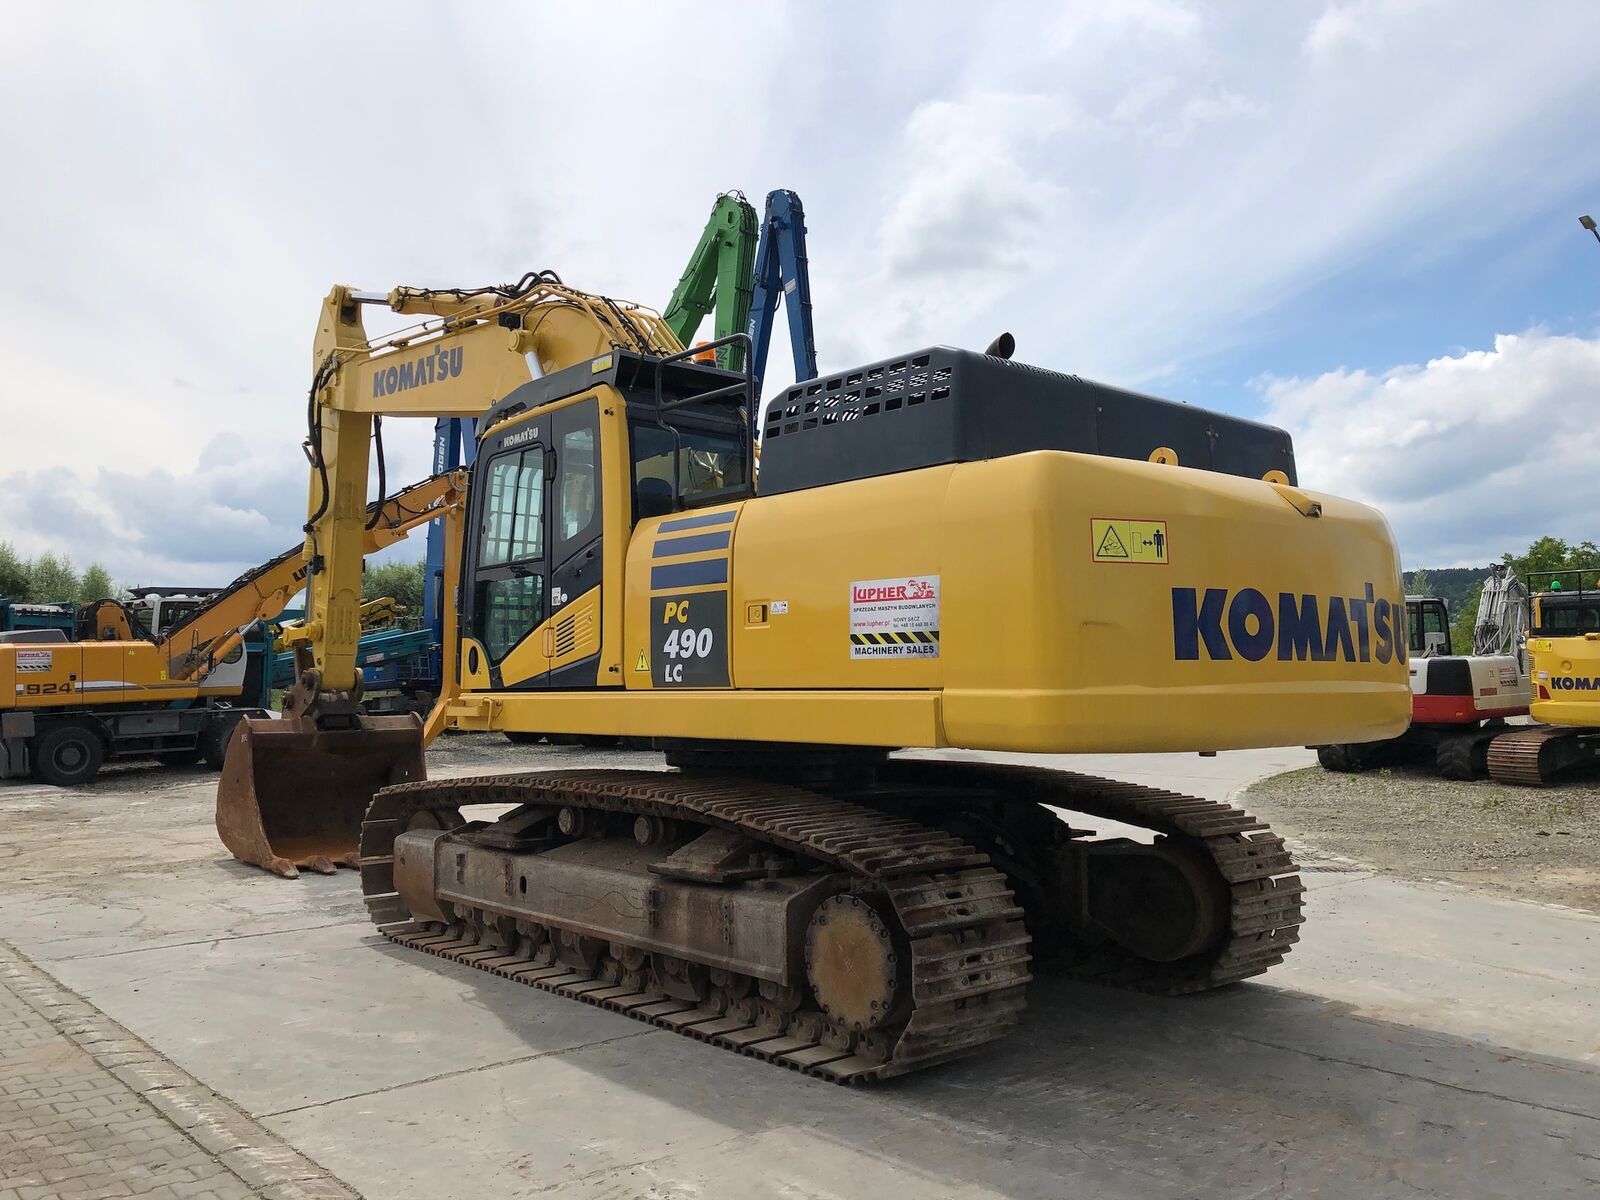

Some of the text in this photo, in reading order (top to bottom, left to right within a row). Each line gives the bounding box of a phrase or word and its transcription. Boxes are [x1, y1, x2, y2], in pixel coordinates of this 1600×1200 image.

[373, 344, 464, 398] KOMATSU
[503, 427, 539, 447] KOMATSU
[854, 585, 908, 603] LUPHER
[663, 600, 689, 624] PC
[853, 620, 890, 628] www.lupher.pl
[1171, 582, 1407, 665] KOMATSU
[663, 627, 713, 659] 490
[854, 645, 935, 655] MACHINERY SALES
[664, 664, 683, 683] LC
[26, 683, 72, 695] 924
